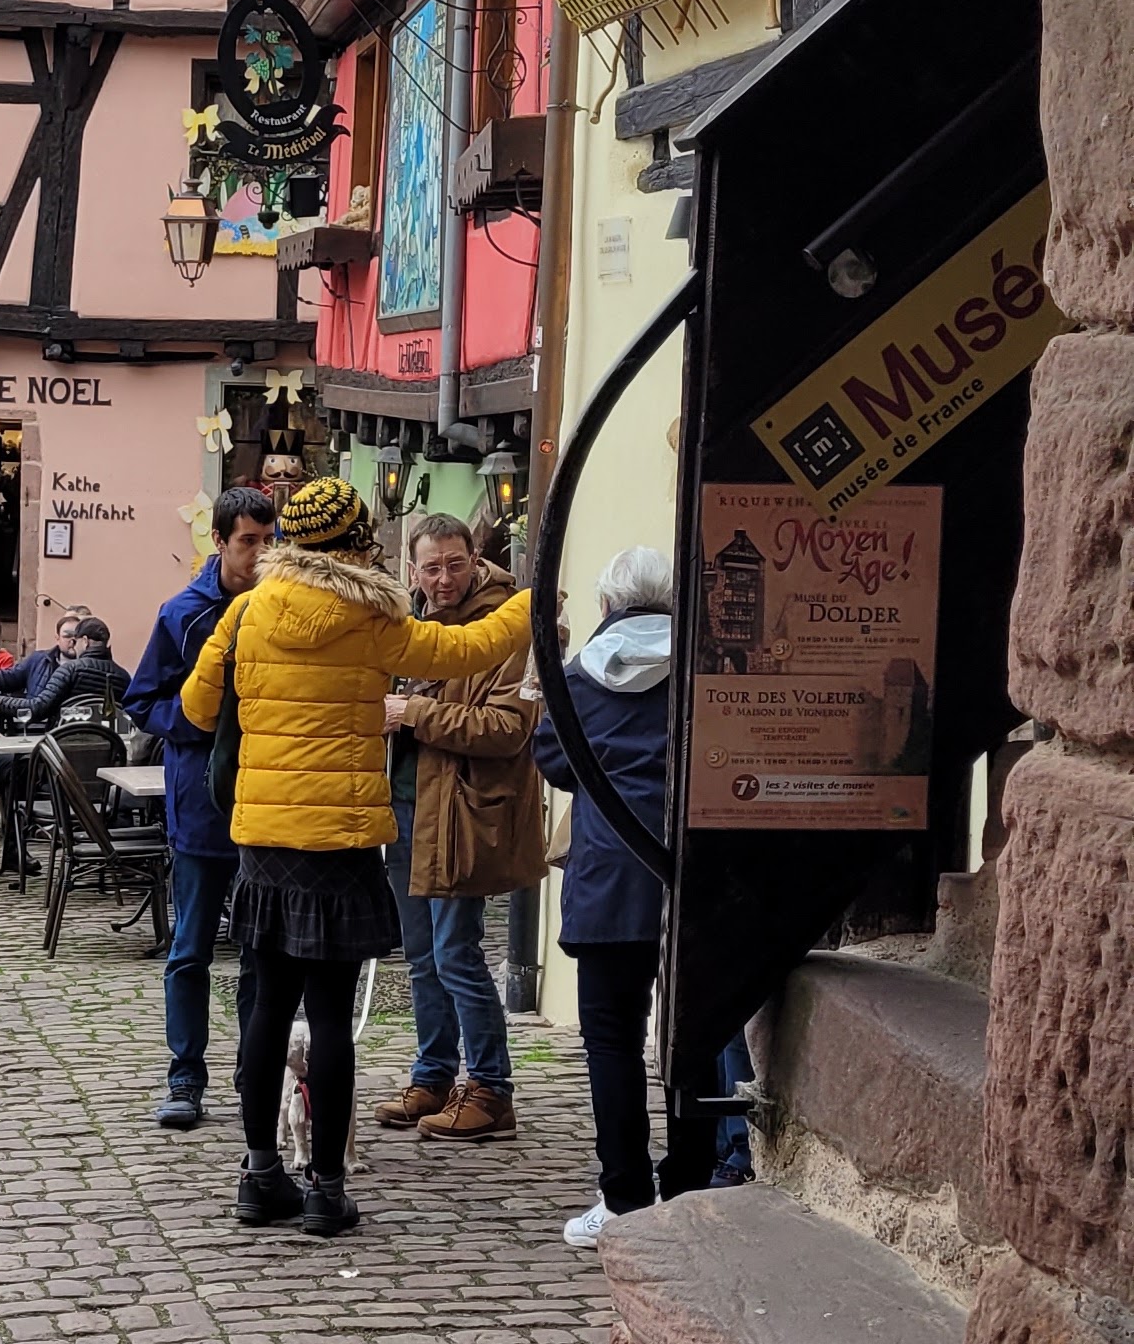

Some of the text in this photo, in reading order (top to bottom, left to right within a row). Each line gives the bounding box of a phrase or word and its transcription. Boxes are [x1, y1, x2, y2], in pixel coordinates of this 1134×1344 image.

[249, 103, 308, 126] Restaurant
[262, 125, 327, 161] Médiéval
[26, 376, 112, 406] NOEL
[827, 376, 985, 513] musée de France
[52, 472, 101, 493] Kathe
[52, 499, 136, 521] Wohlfahrt
[772, 518, 888, 572] Moyen
[831, 593, 847, 603] DU
[808, 603, 902, 623] DOLDER
[706, 689, 866, 705] TOUR DES VOLEURS
[737, 707, 776, 717] MAISON
[780, 707, 793, 717] DE
[796, 707, 850, 718] VIGNERON
[765, 780, 780, 789] les
[782, 781, 789, 789] 2
[793, 780, 824, 789] visites
[827, 780, 840, 789] de
[842, 780, 875, 789] musée
